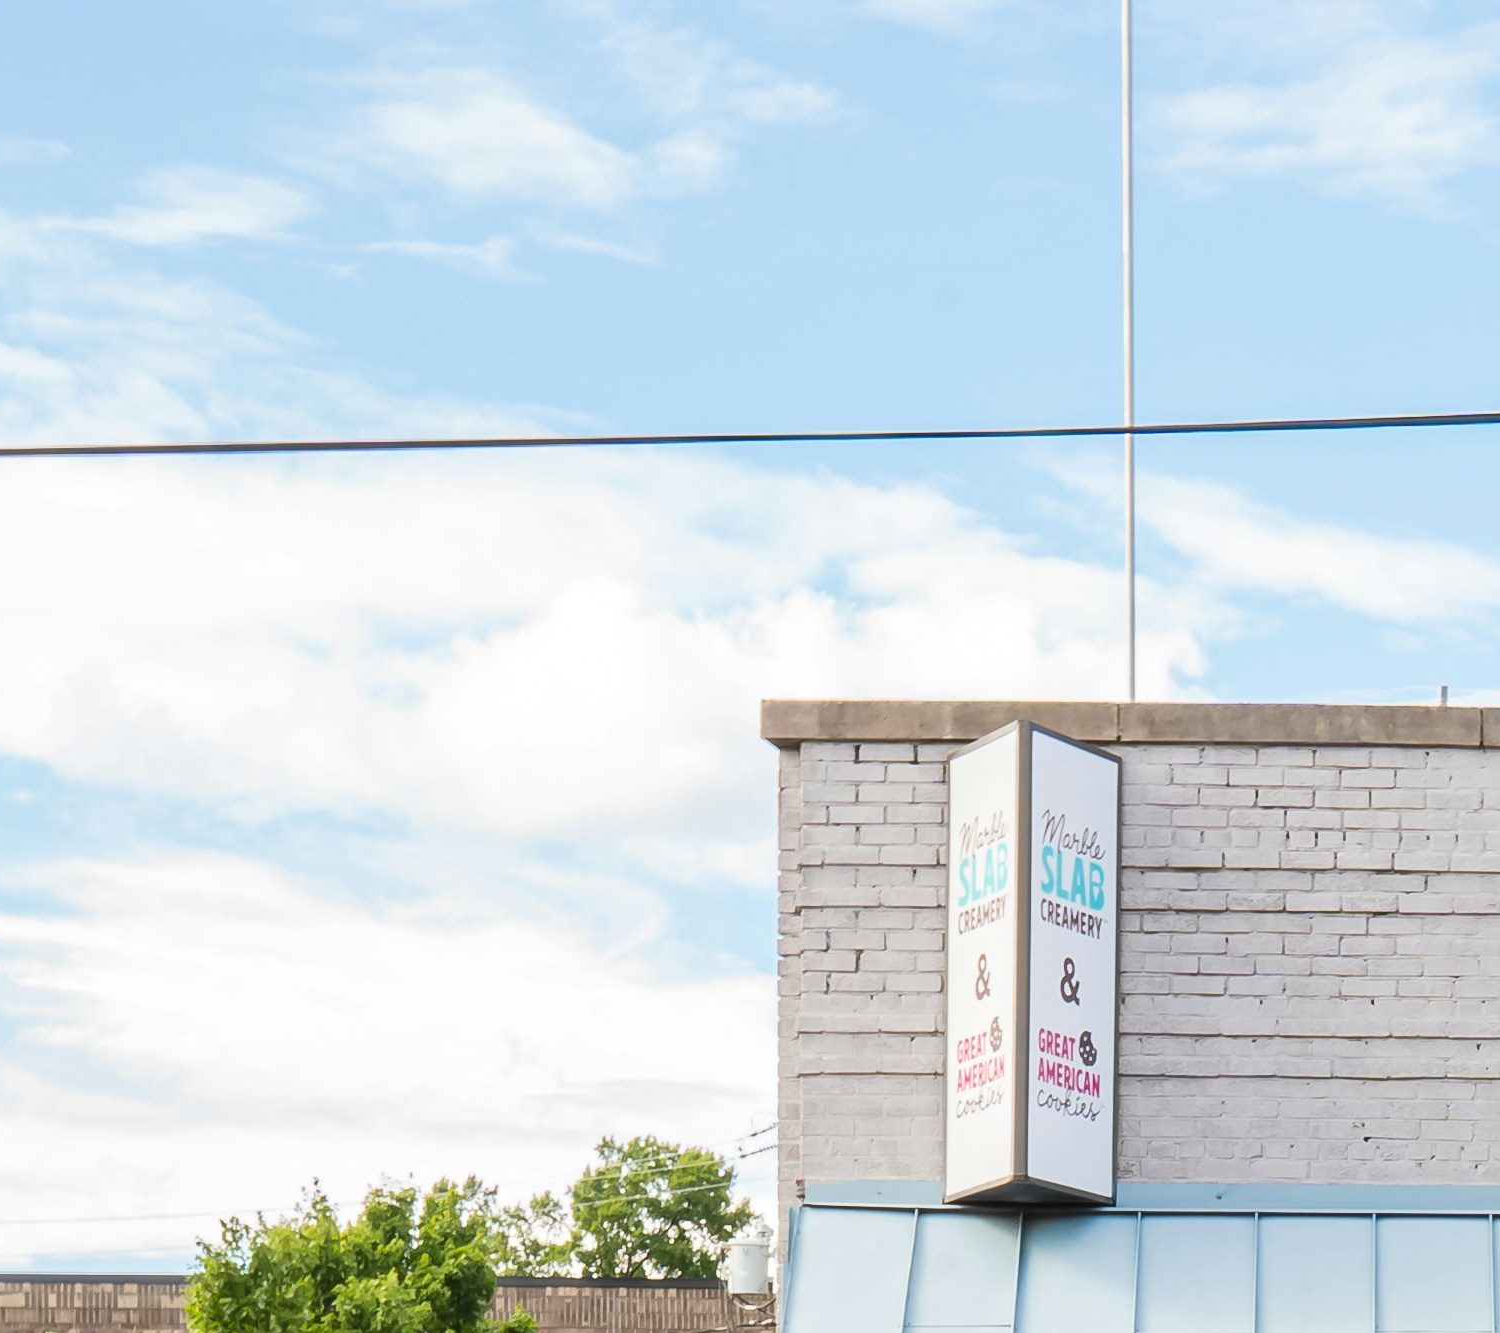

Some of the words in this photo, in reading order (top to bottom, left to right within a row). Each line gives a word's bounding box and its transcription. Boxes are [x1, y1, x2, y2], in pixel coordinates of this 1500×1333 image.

[959, 811, 1009, 858] Marble
[1041, 808, 1106, 861] Marble
[958, 842, 1009, 907] SLAB
[1040, 844, 1105, 911] SLAB
[957, 894, 1006, 935] CREAMERY
[1040, 897, 1102, 940] CREAMERY
[975, 953, 991, 1000] &
[1060, 956, 1080, 1006] &
[957, 1031, 987, 1064] GREAT
[1038, 1027, 1076, 1062] GREAT
[956, 1054, 1005, 1093] AMERICAN
[1037, 1057, 1101, 1098] AMERICAN
[956, 1083, 1005, 1119] cookies
[1036, 1085, 1101, 1122] cookies
